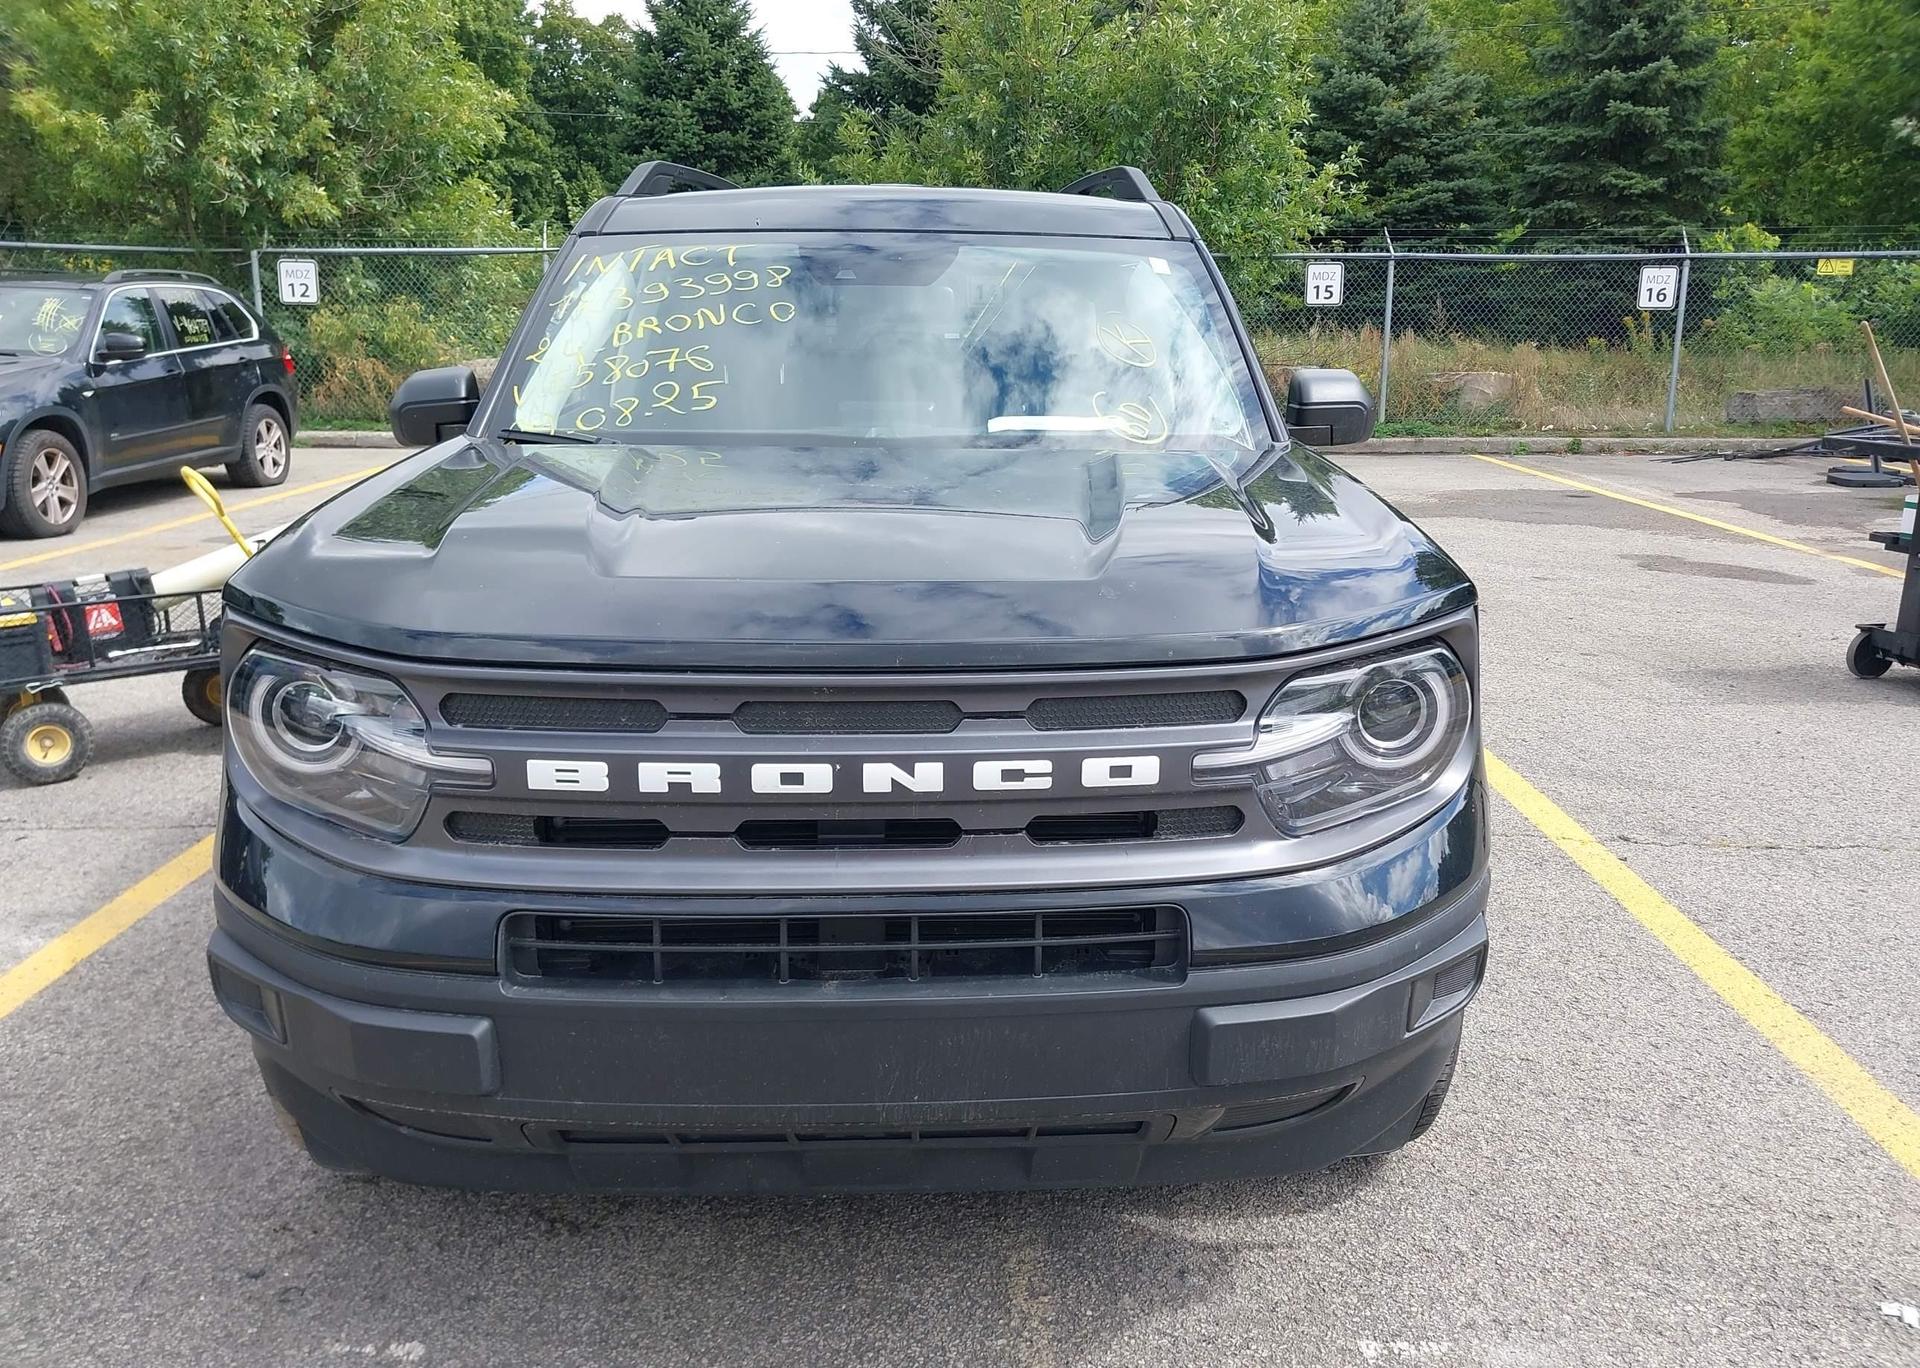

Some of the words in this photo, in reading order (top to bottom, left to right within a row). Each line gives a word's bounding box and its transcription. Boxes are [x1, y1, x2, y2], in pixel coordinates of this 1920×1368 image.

[563, 244, 742, 285] INTACT
[285, 269, 311, 280] MDZ
[1312, 271, 1337, 281] MDZ
[1646, 274, 1671, 285] MDZ
[288, 282, 310, 298] 12
[1313, 285, 1334, 300] 15
[1646, 287, 1667, 303] 16
[612, 302, 796, 347] BRONCO
[575, 381, 725, 431] 08-25
[526, 755, 1160, 794] BRONCO
